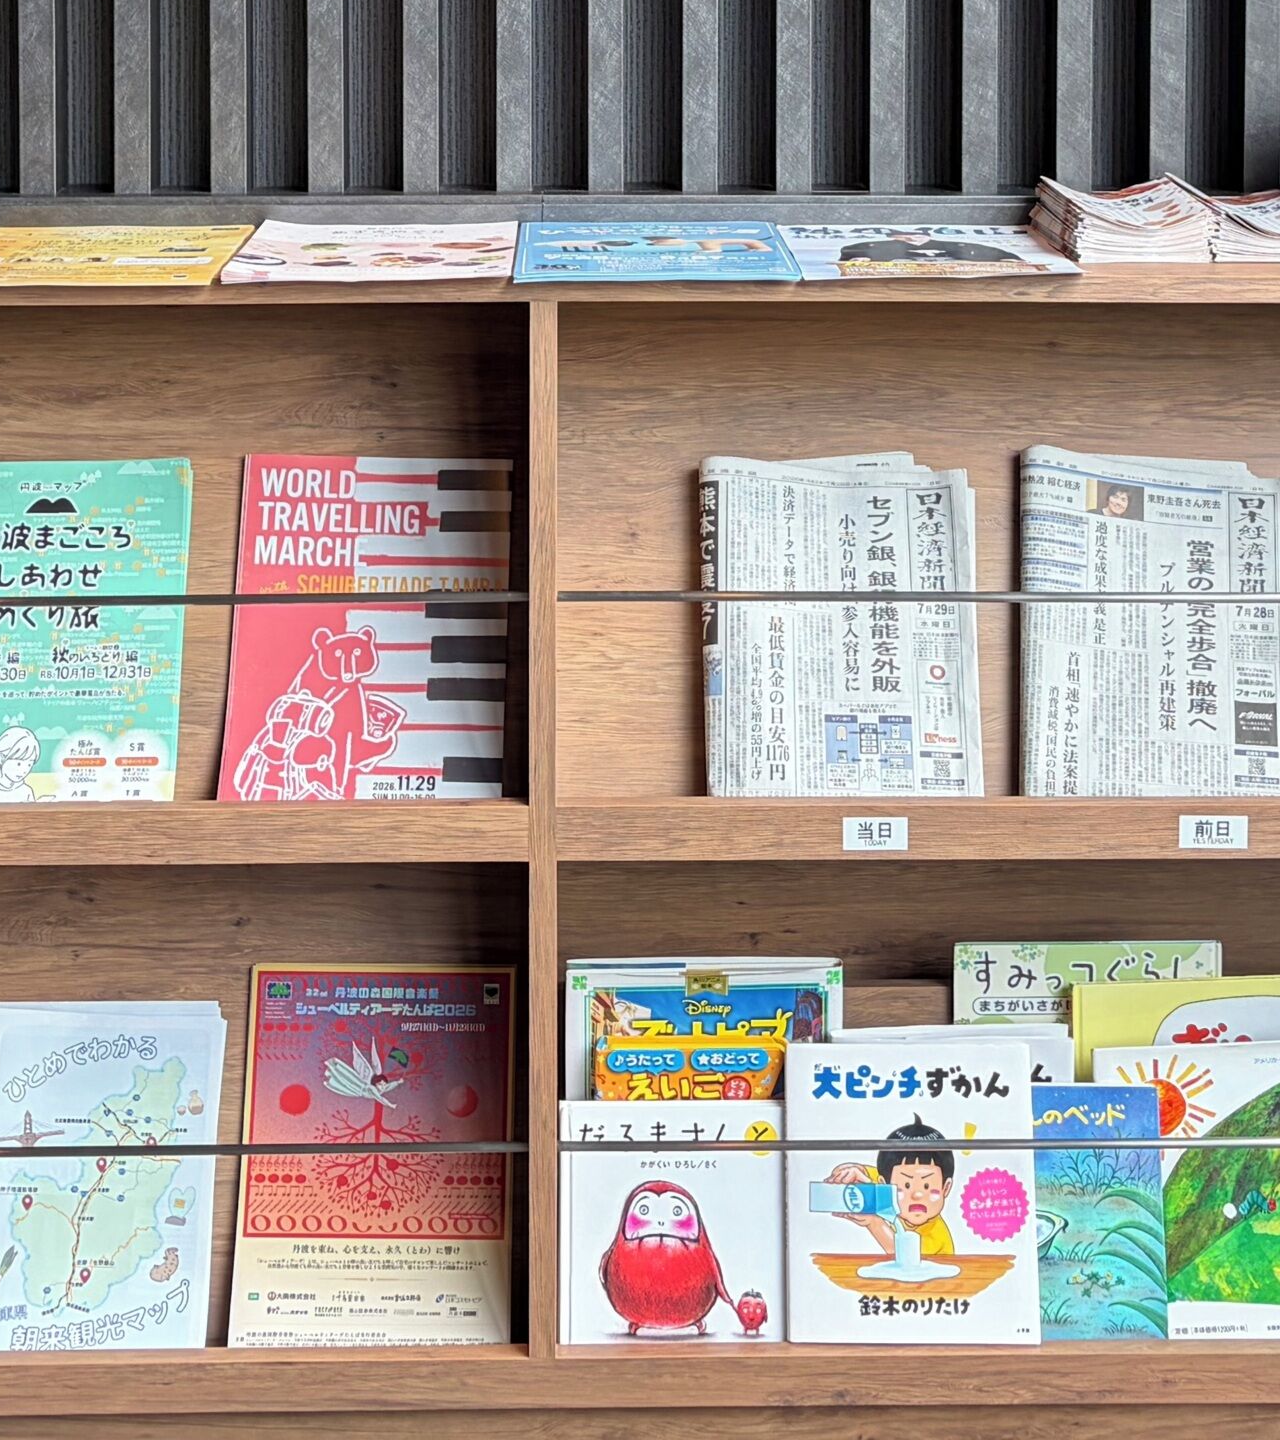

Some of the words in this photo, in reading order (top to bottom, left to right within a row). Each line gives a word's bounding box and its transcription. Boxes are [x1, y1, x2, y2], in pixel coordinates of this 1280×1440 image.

[261, 467, 357, 499] WORLD
[1146, 493, 1222, 511] 東野圭吾さん死去
[258, 501, 421, 535] TRAVELLING
[253, 535, 369, 567] MARCHE
[912, 491, 948, 592] 日本経済新聞
[1234, 497, 1270, 593] 日本経済新聞
[296, 573, 433, 594] SCHUBERTIADE
[1093, 520, 1108, 646] 過度な成果義是正
[917, 603, 955, 615] 7月29日
[1235, 605, 1275, 619] 7月28日
[920, 620, 951, 629] 水曜日
[1238, 622, 1271, 631] 火曜日
[1186, 539, 1219, 732] 営業の完全歩合」撤廃へ
[766, 615, 790, 781] 最低賃金の目安1176円
[1235, 688, 1276, 698] フォーバル
[69, 746, 101, 757] たんば賞
[77, 738, 94, 748] 極み
[857, 821, 892, 840] 当日
[1194, 820, 1230, 839] 前日
[864, 839, 887, 847] TODAY
[1192, 837, 1235, 845] YESTERDAY
[295, 1002, 477, 1017] シューベルティアーデたんば2026
[2, 1034, 158, 1103] ひとめでわかる
[625, 1053, 676, 1066] うたって
[710, 1052, 761, 1065] おどって
[627, 1072, 726, 1100] えいご
[812, 1064, 1010, 1099] 大ピンチずかん
[640, 1160, 671, 1169] かがくい
[847, 1183, 864, 1210] MILK
[969, 1198, 1022, 1209] ピンチが来ても
[858, 1295, 971, 1316] 鈴木のりたけ
[10, 1279, 189, 1352] 朝来観光マップ
